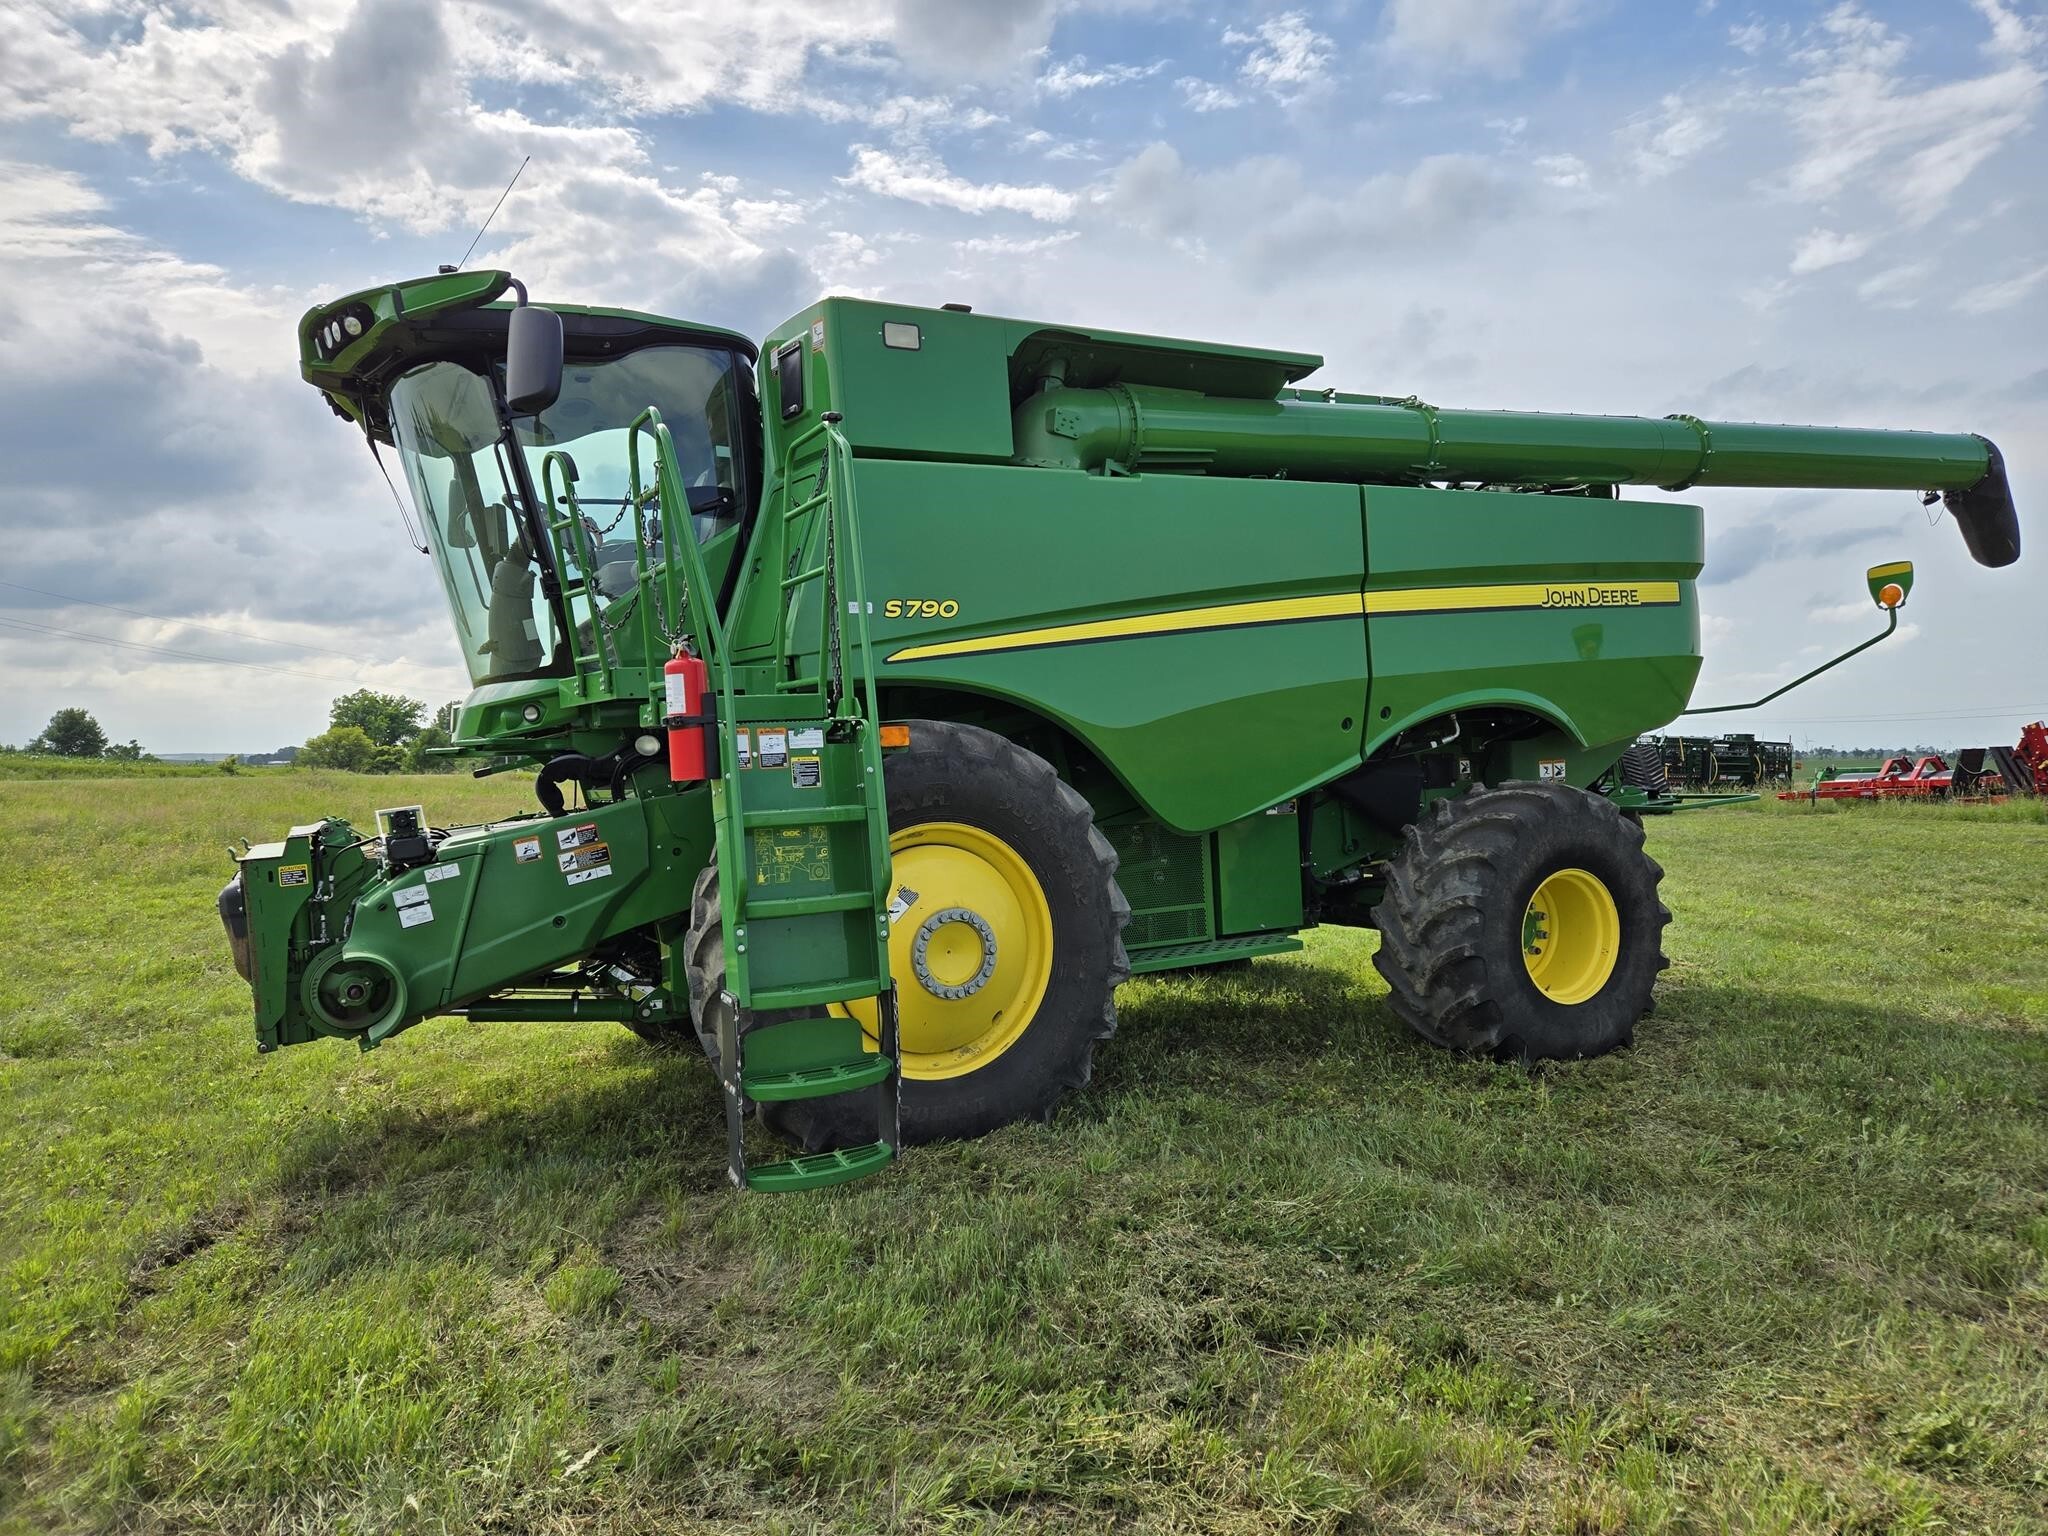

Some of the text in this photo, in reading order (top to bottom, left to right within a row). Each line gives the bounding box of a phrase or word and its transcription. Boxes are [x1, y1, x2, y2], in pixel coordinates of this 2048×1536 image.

[1542, 587, 1640, 606] JOHN DEERE
[884, 599, 959, 618] S790
